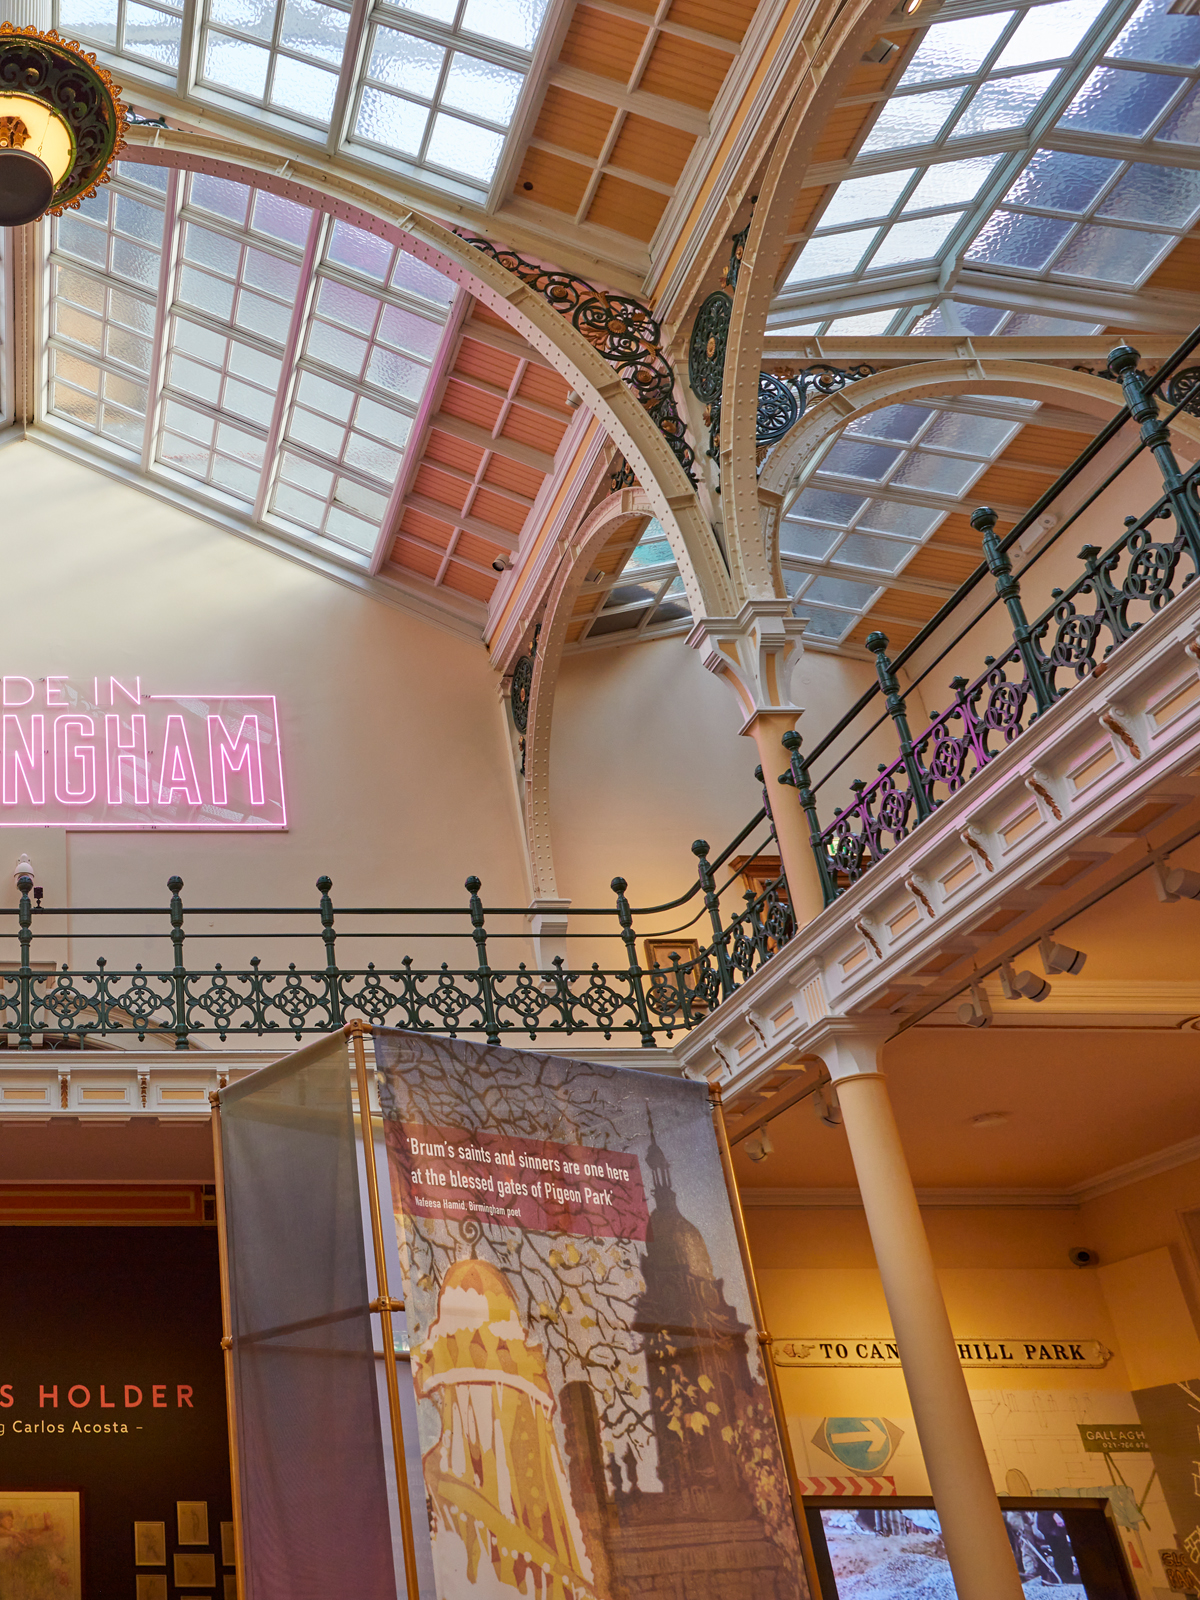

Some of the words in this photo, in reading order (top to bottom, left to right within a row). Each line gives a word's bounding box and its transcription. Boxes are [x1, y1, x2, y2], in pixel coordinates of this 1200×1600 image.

[94, 675, 144, 706] IN
[458, 1144, 492, 1164] saints
[494, 1149, 516, 1167] and
[518, 1151, 561, 1172] sinners
[563, 1160, 580, 1176] are
[584, 1163, 604, 1178] one
[606, 1162, 630, 1182] here
[410, 1169, 423, 1184] at
[425, 1169, 447, 1187] the
[449, 1170, 495, 1192] blessed
[497, 1180, 529, 1198] gates
[530, 1181, 542, 1198] of
[544, 1182, 582, 1205] Pigeon
[414, 1196, 441, 1209] Nafeesa
[443, 1199, 468, 1211] Hamid,
[468, 1200, 506, 1216] Birmingham
[506, 1207, 521, 1218] poet
[819, 1343, 849, 1360] TO
[957, 1343, 1014, 1361] HILL
[1024, 1343, 1087, 1361] PARK
[39, 1384, 195, 1408] HOLDER
[12, 1420, 66, 1434] Carlos
[71, 1420, 129, 1434] Acosta
